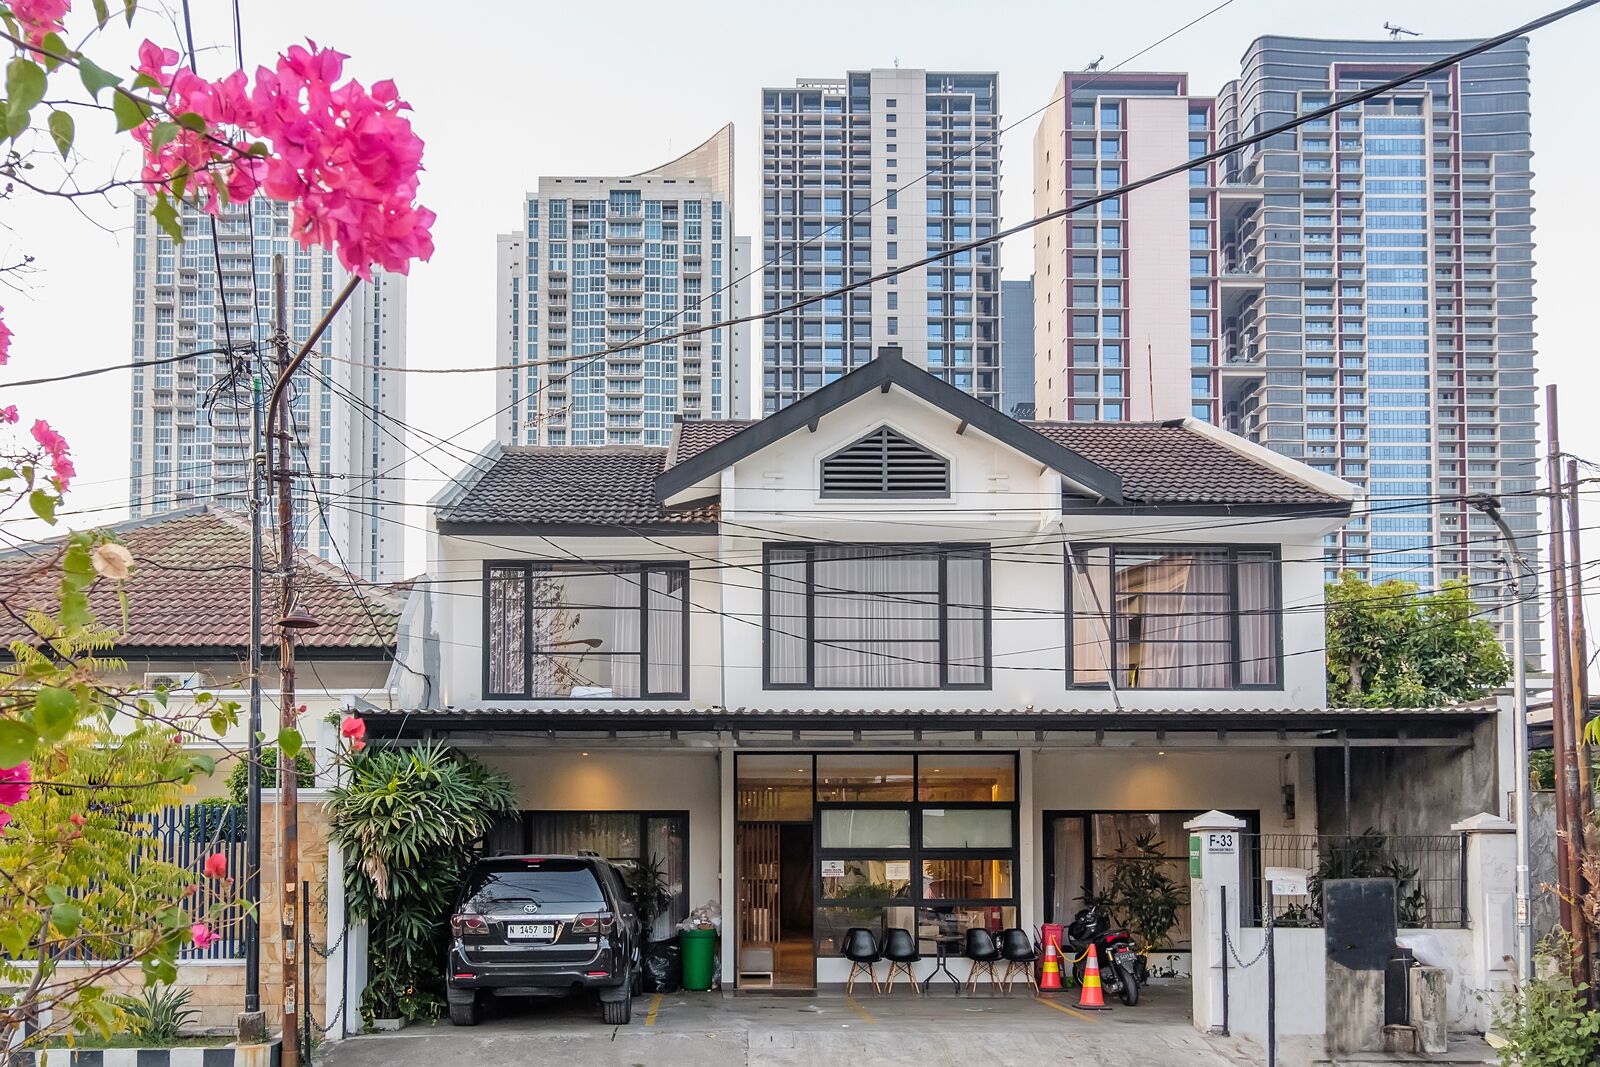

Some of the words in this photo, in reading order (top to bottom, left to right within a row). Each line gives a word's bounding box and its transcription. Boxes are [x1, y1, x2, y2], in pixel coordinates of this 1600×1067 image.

[1209, 834, 1232, 847] F-33
[509, 926, 515, 934] N
[520, 926, 538, 934] 1457
